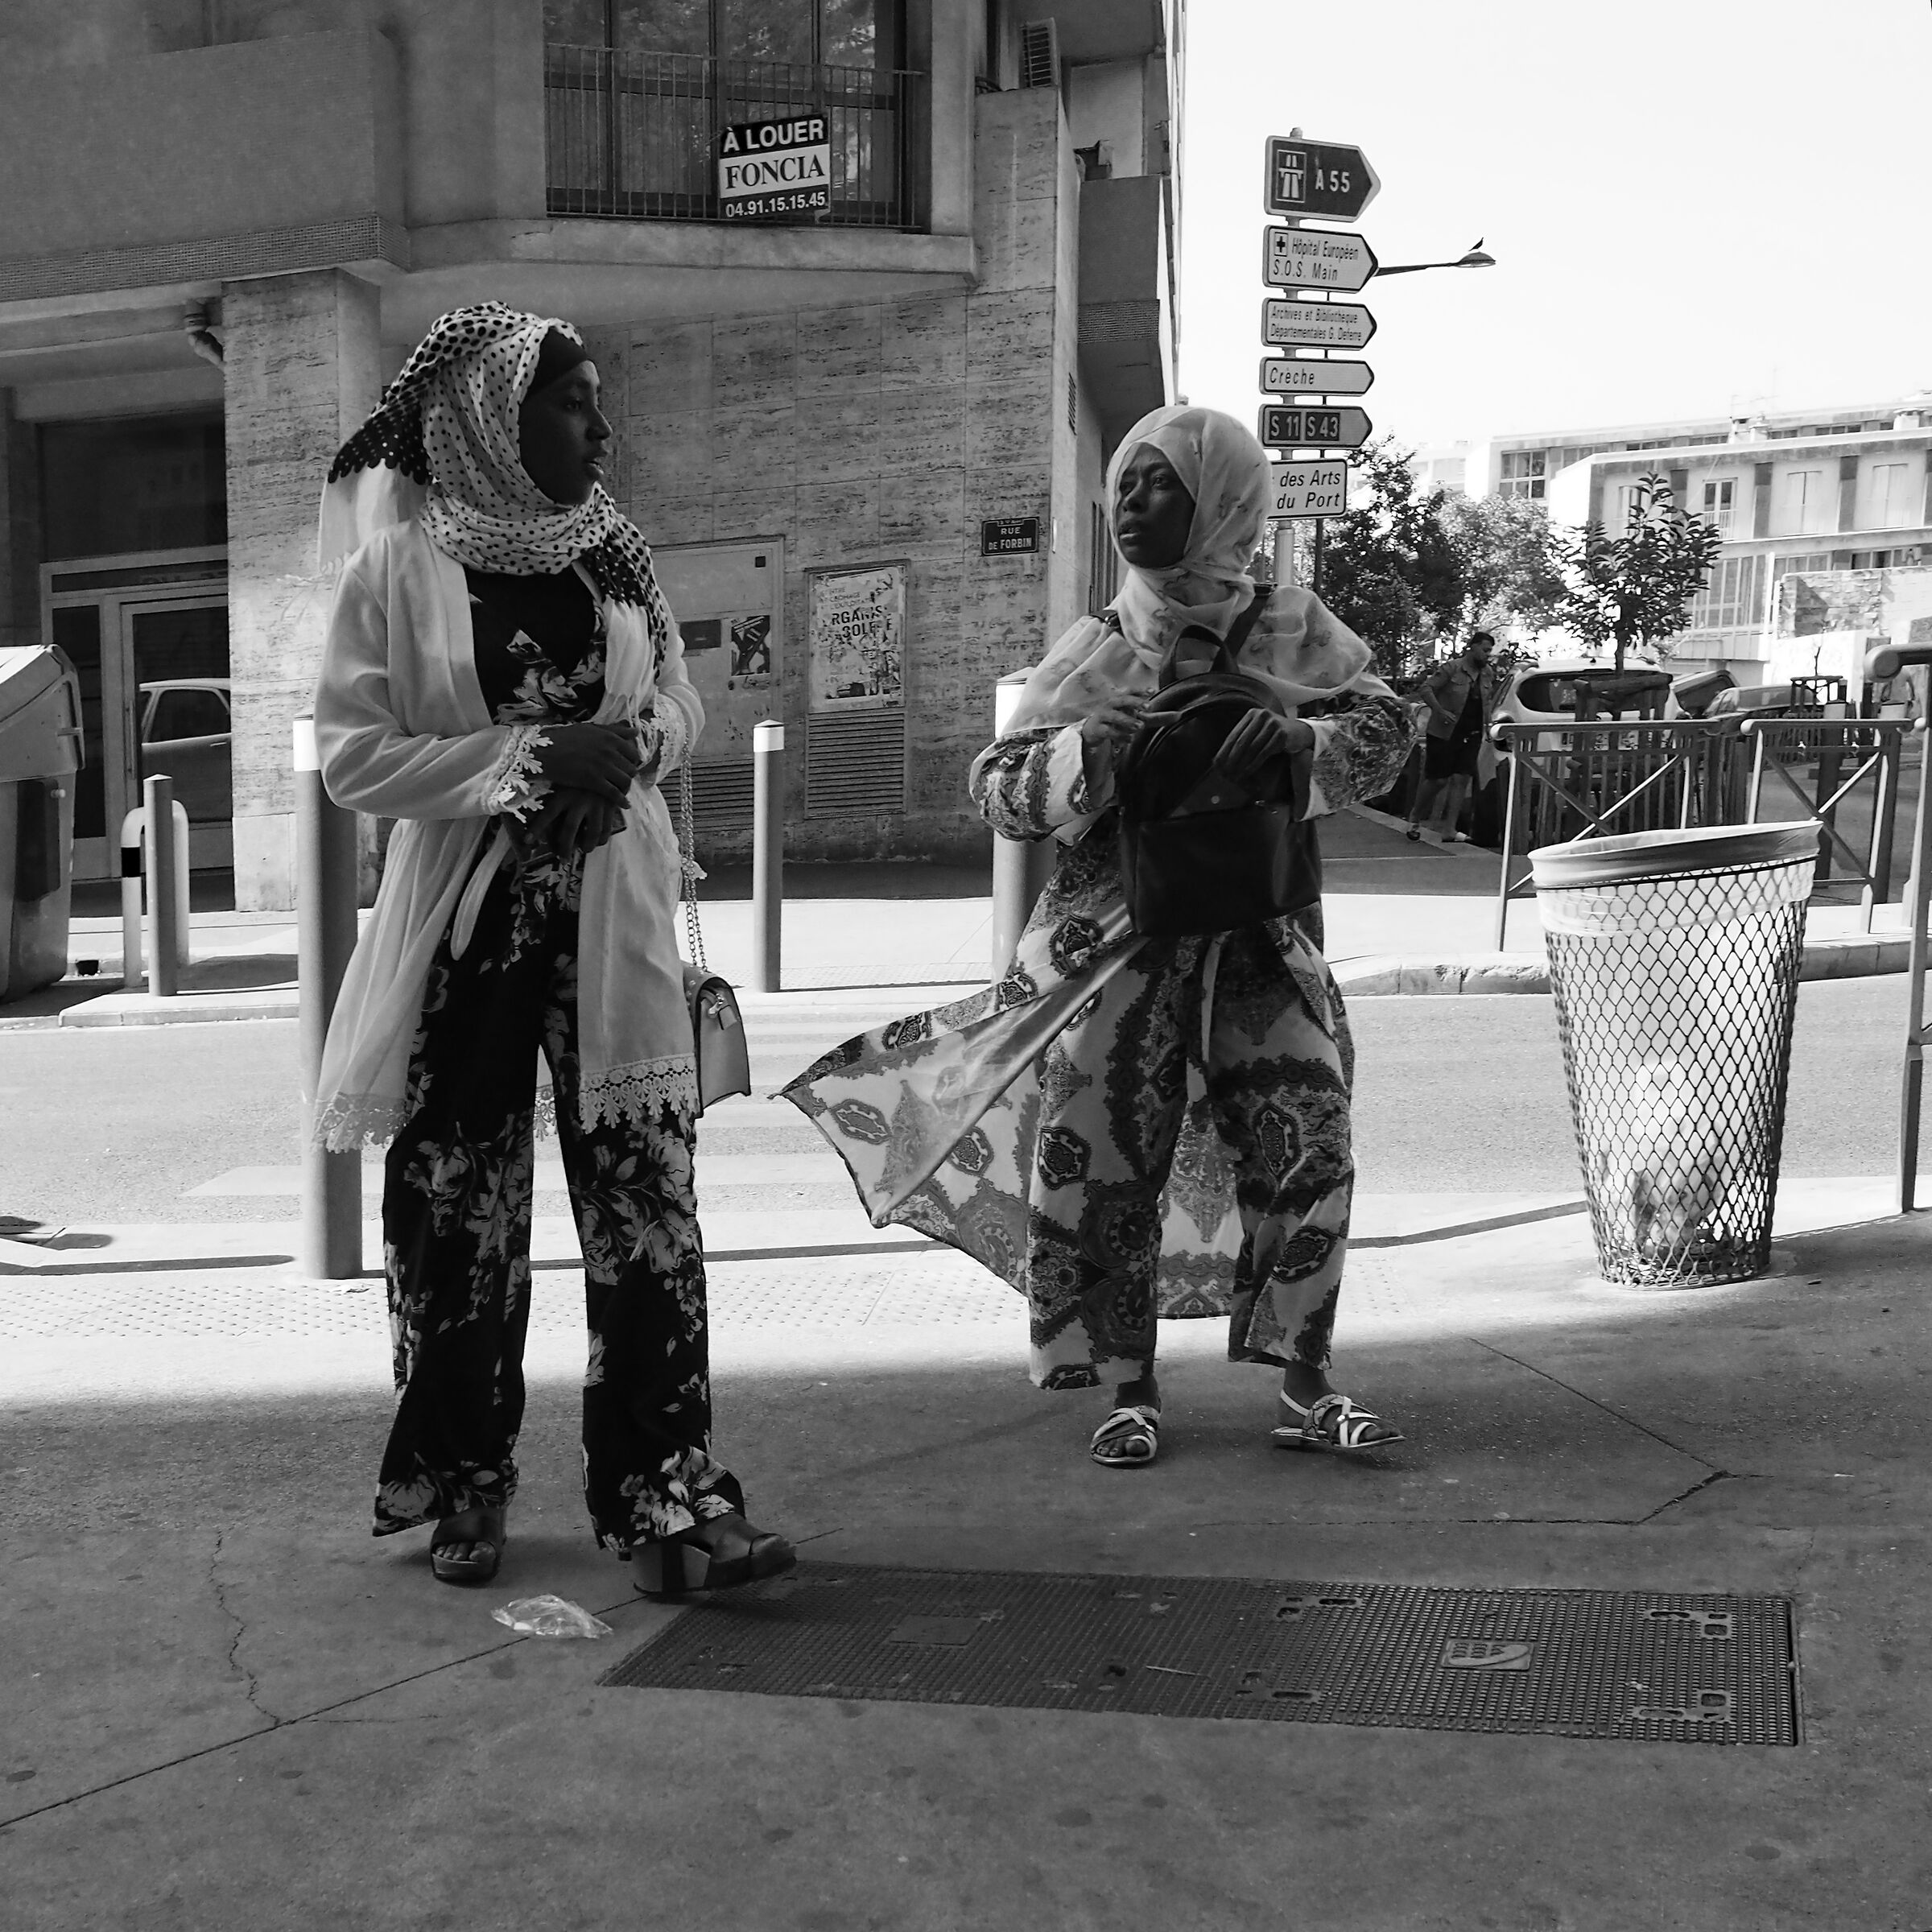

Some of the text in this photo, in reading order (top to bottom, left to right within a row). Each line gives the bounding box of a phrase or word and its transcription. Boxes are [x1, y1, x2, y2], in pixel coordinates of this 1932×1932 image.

[723, 118, 824, 153] À LOUER
[724, 154, 826, 189] FONCIA
[1315, 168, 1350, 192] A 55
[725, 191, 826, 218] 04.91.15.15.45
[1292, 237, 1320, 259] Hôpital
[1311, 262, 1337, 281] Main
[1269, 367, 1315, 385] Crèche
[1320, 416, 1338, 438] 43
[1280, 469, 1341, 488] des Arts
[1277, 492, 1340, 510] du Port
[1001, 526, 1021, 535] RUE
[988, 537, 1032, 551] DE FORBIN
